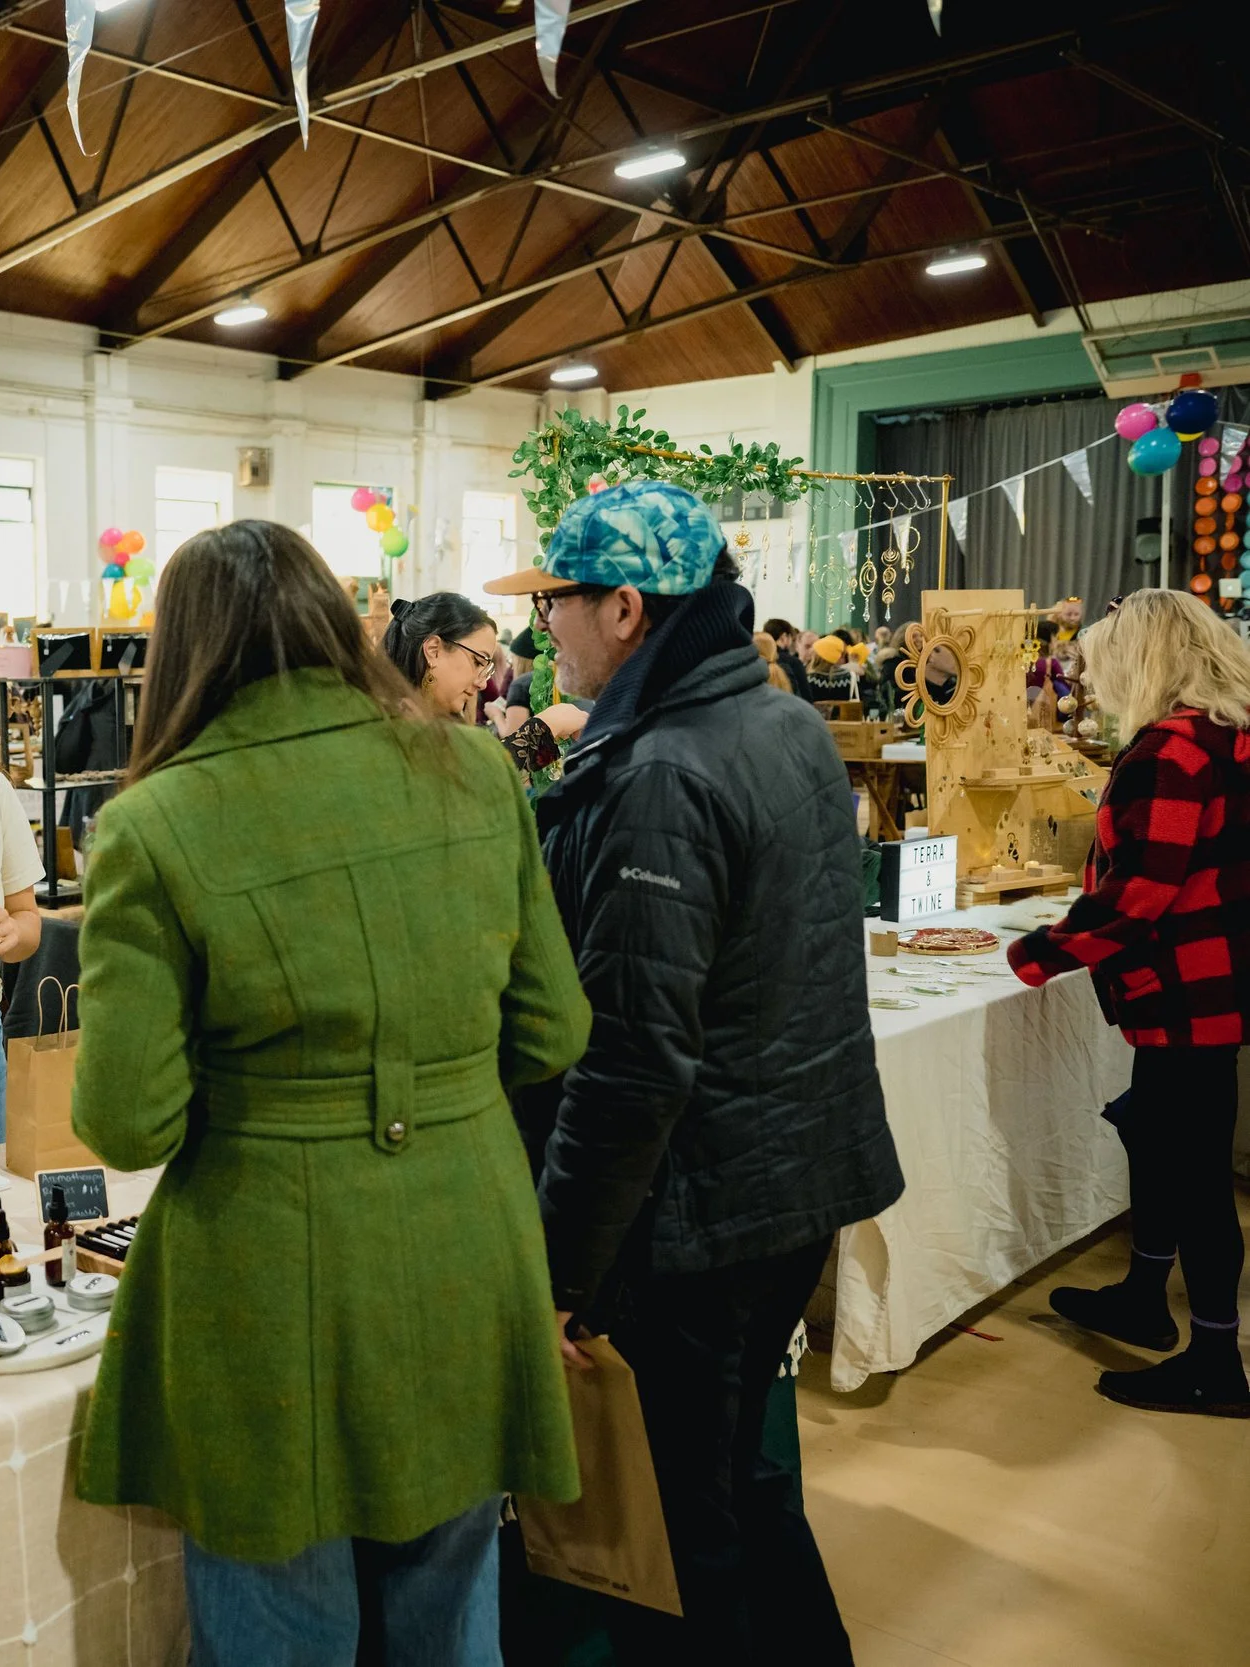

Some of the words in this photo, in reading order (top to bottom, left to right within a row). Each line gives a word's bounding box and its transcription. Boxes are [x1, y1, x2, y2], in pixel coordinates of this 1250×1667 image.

[913, 843, 945, 865] TERRA
[629, 867, 681, 890] Columbia
[926, 870, 931, 887] &
[911, 893, 942, 915] TWINE
